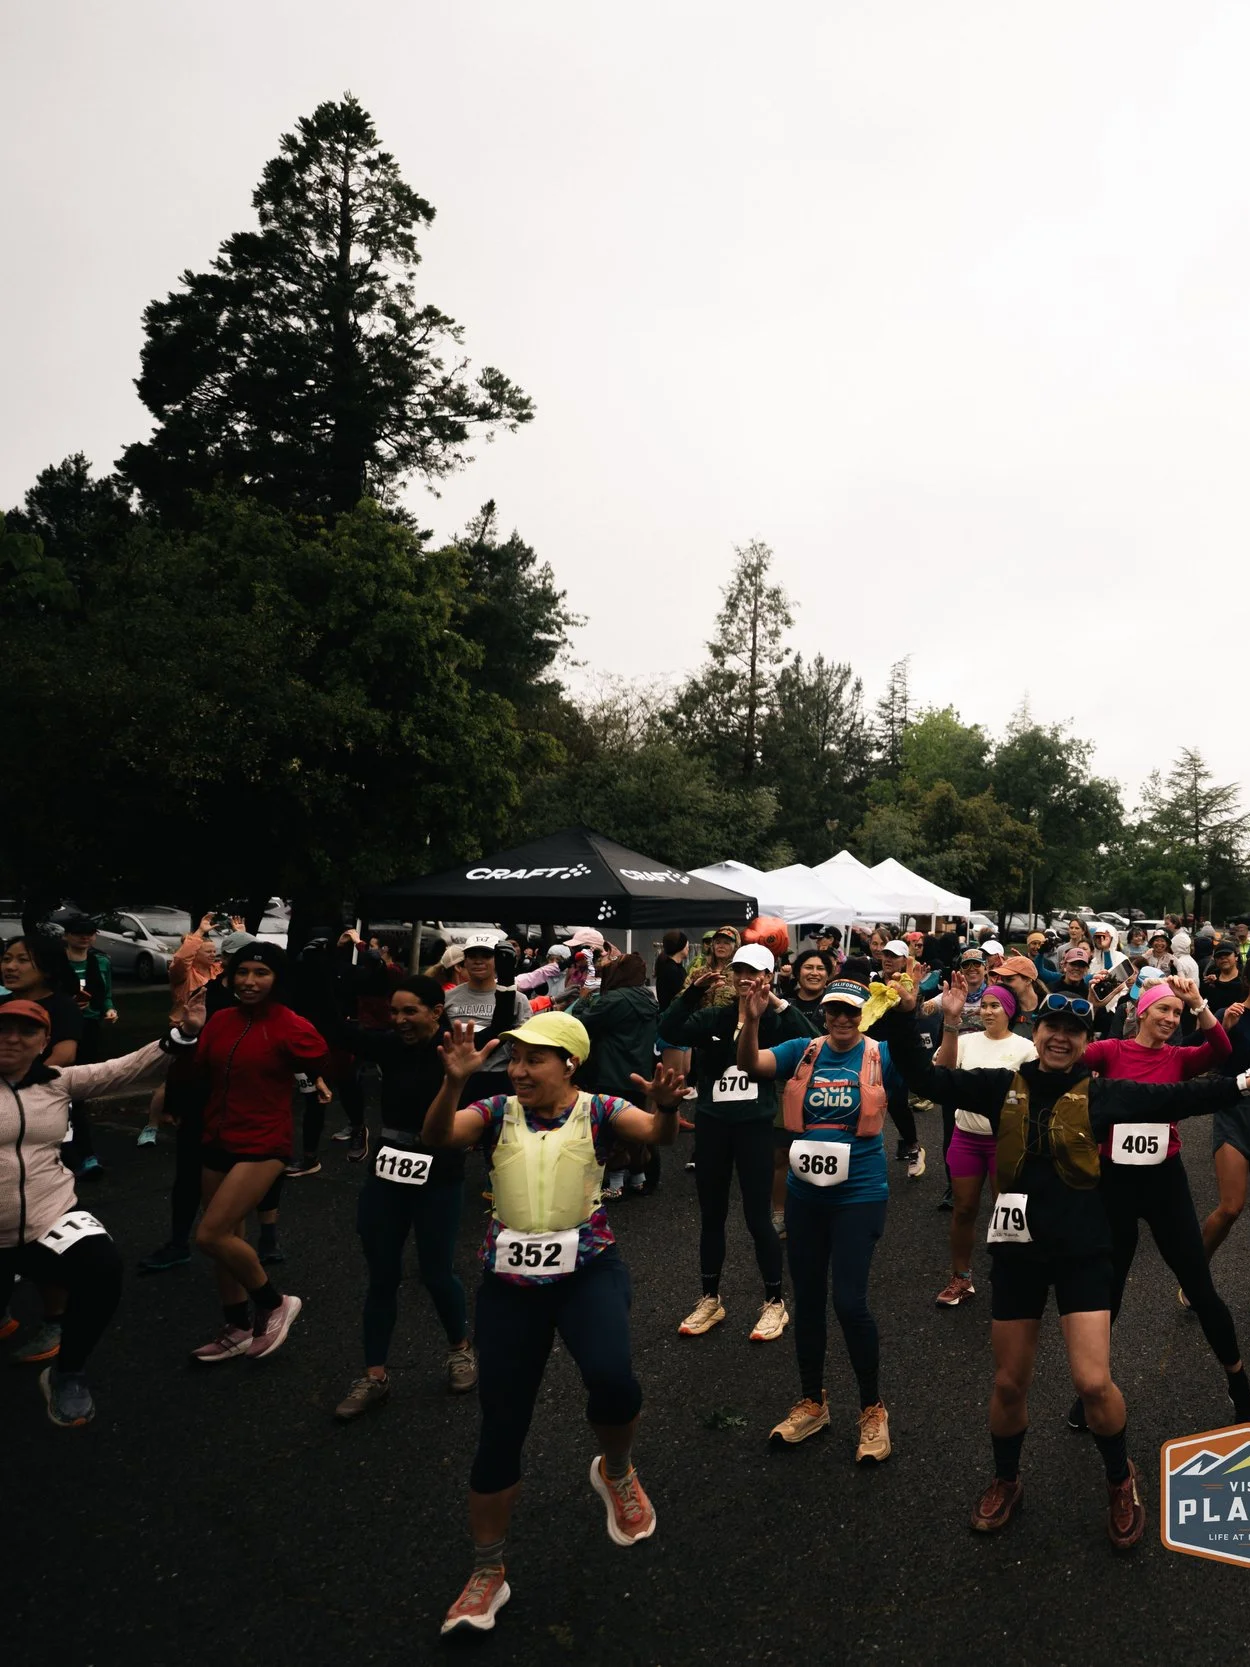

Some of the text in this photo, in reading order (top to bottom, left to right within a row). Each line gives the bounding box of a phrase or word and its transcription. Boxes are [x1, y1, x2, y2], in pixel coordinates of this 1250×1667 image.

[466, 868, 569, 880] CRAFT
[619, 869, 676, 882] CRAFT
[832, 982, 862, 992] CALIFORNIA
[719, 1076, 749, 1092] 670
[809, 1092, 852, 1107] Club
[1122, 1135, 1158, 1154] 405
[379, 1154, 428, 1179] 1182
[799, 1154, 837, 1175] 368
[508, 1242, 562, 1267] 352
